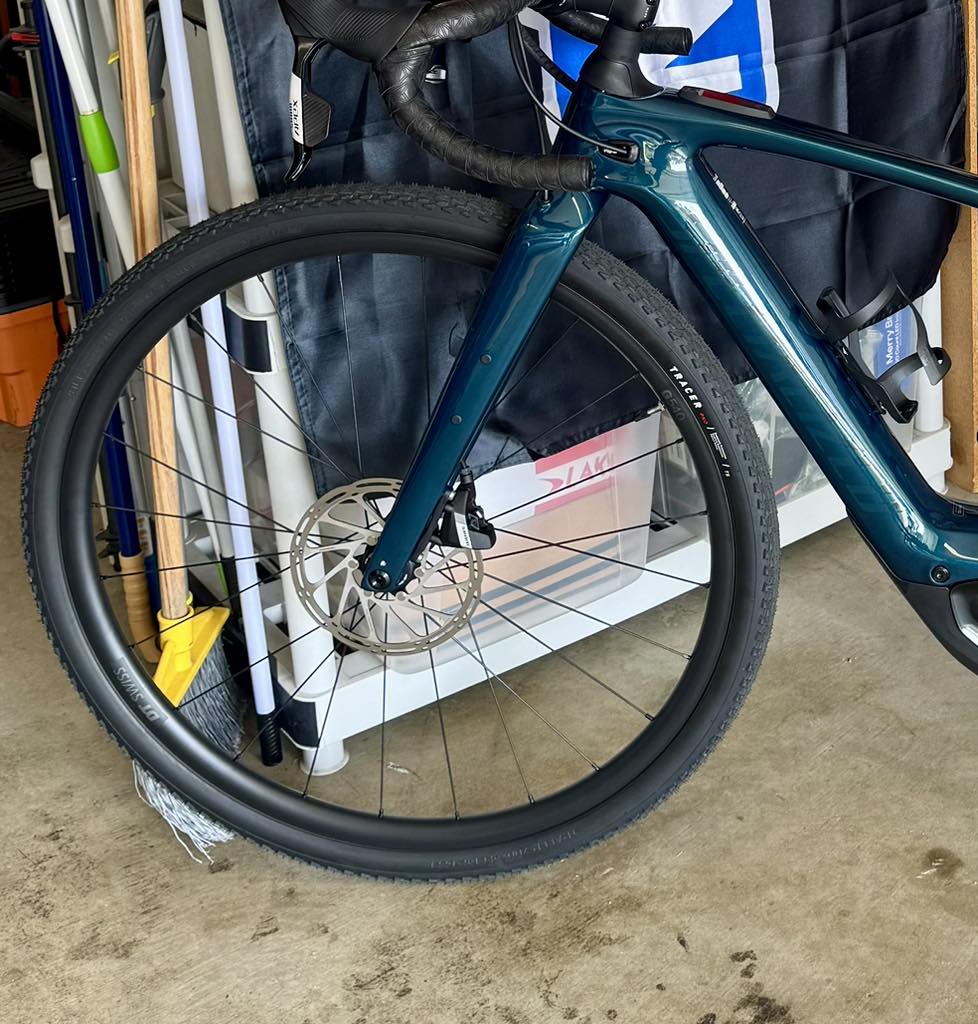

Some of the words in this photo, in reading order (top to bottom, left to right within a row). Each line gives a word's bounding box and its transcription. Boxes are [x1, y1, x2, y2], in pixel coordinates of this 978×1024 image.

[886, 330, 895, 365] Merry
[670, 366, 702, 409] TRACER
[113, 667, 144, 702] SWISS
